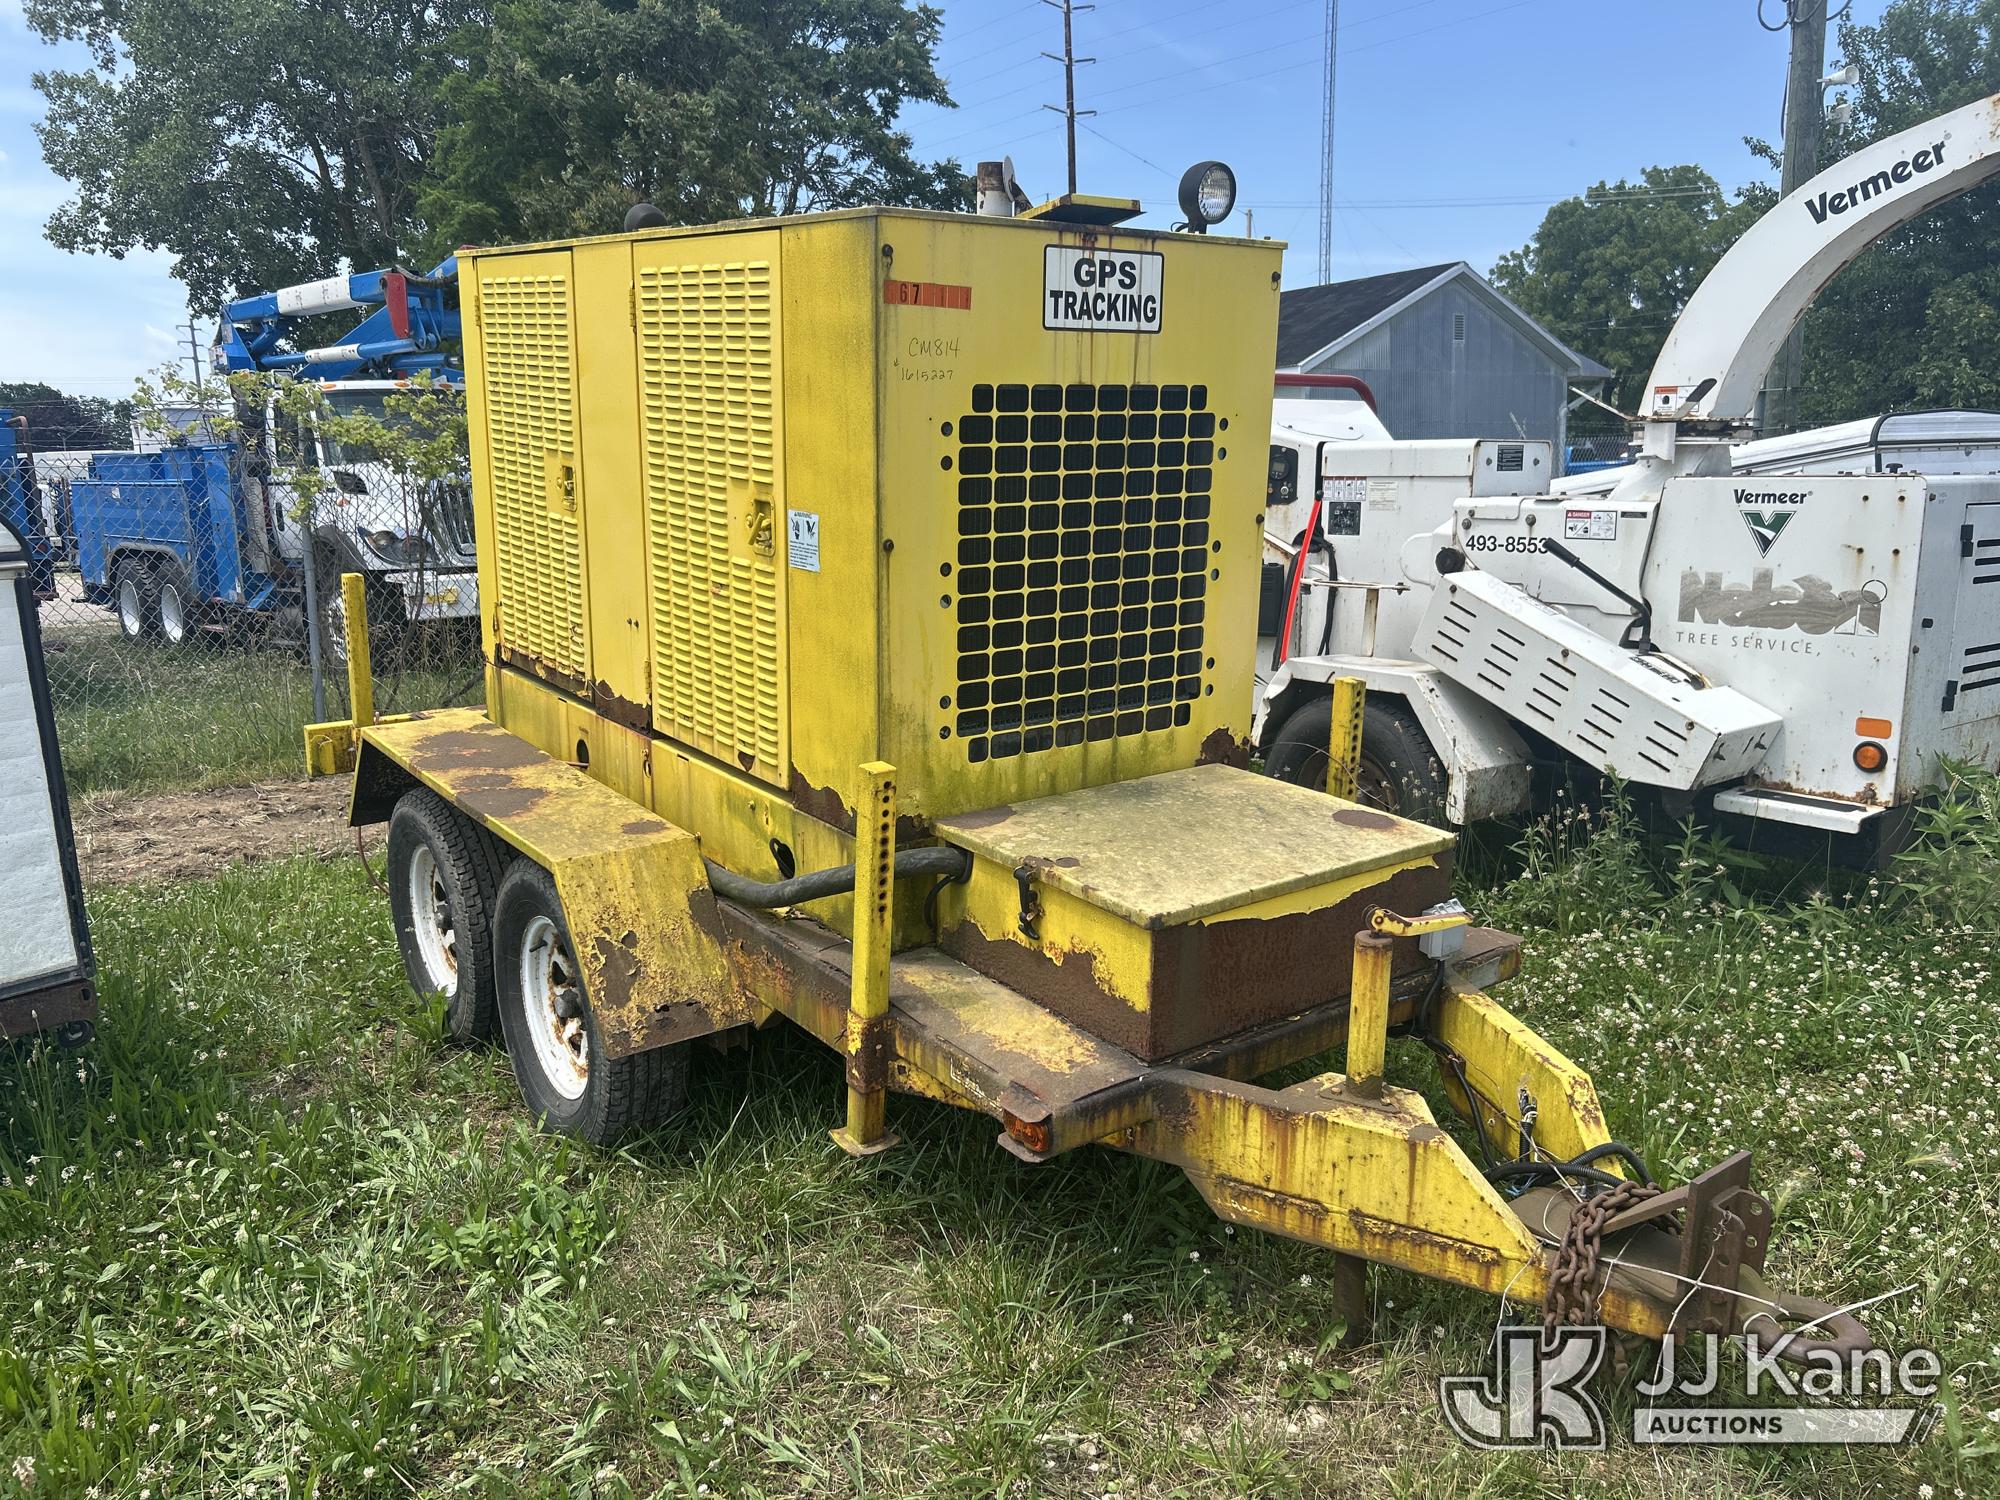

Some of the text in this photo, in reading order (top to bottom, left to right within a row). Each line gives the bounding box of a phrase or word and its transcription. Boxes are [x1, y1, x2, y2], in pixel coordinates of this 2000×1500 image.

[1804, 140, 1946, 225] Vermeer
[1073, 257, 1137, 290] GPS
[1049, 289, 1157, 323] TRACKING
[908, 337, 960, 358] CM814
[901, 367, 954, 382] 1615227
[1733, 488, 1808, 505] Vermeer
[1465, 534, 1549, 555] 493-8553
[1676, 631, 1719, 646] TREE
